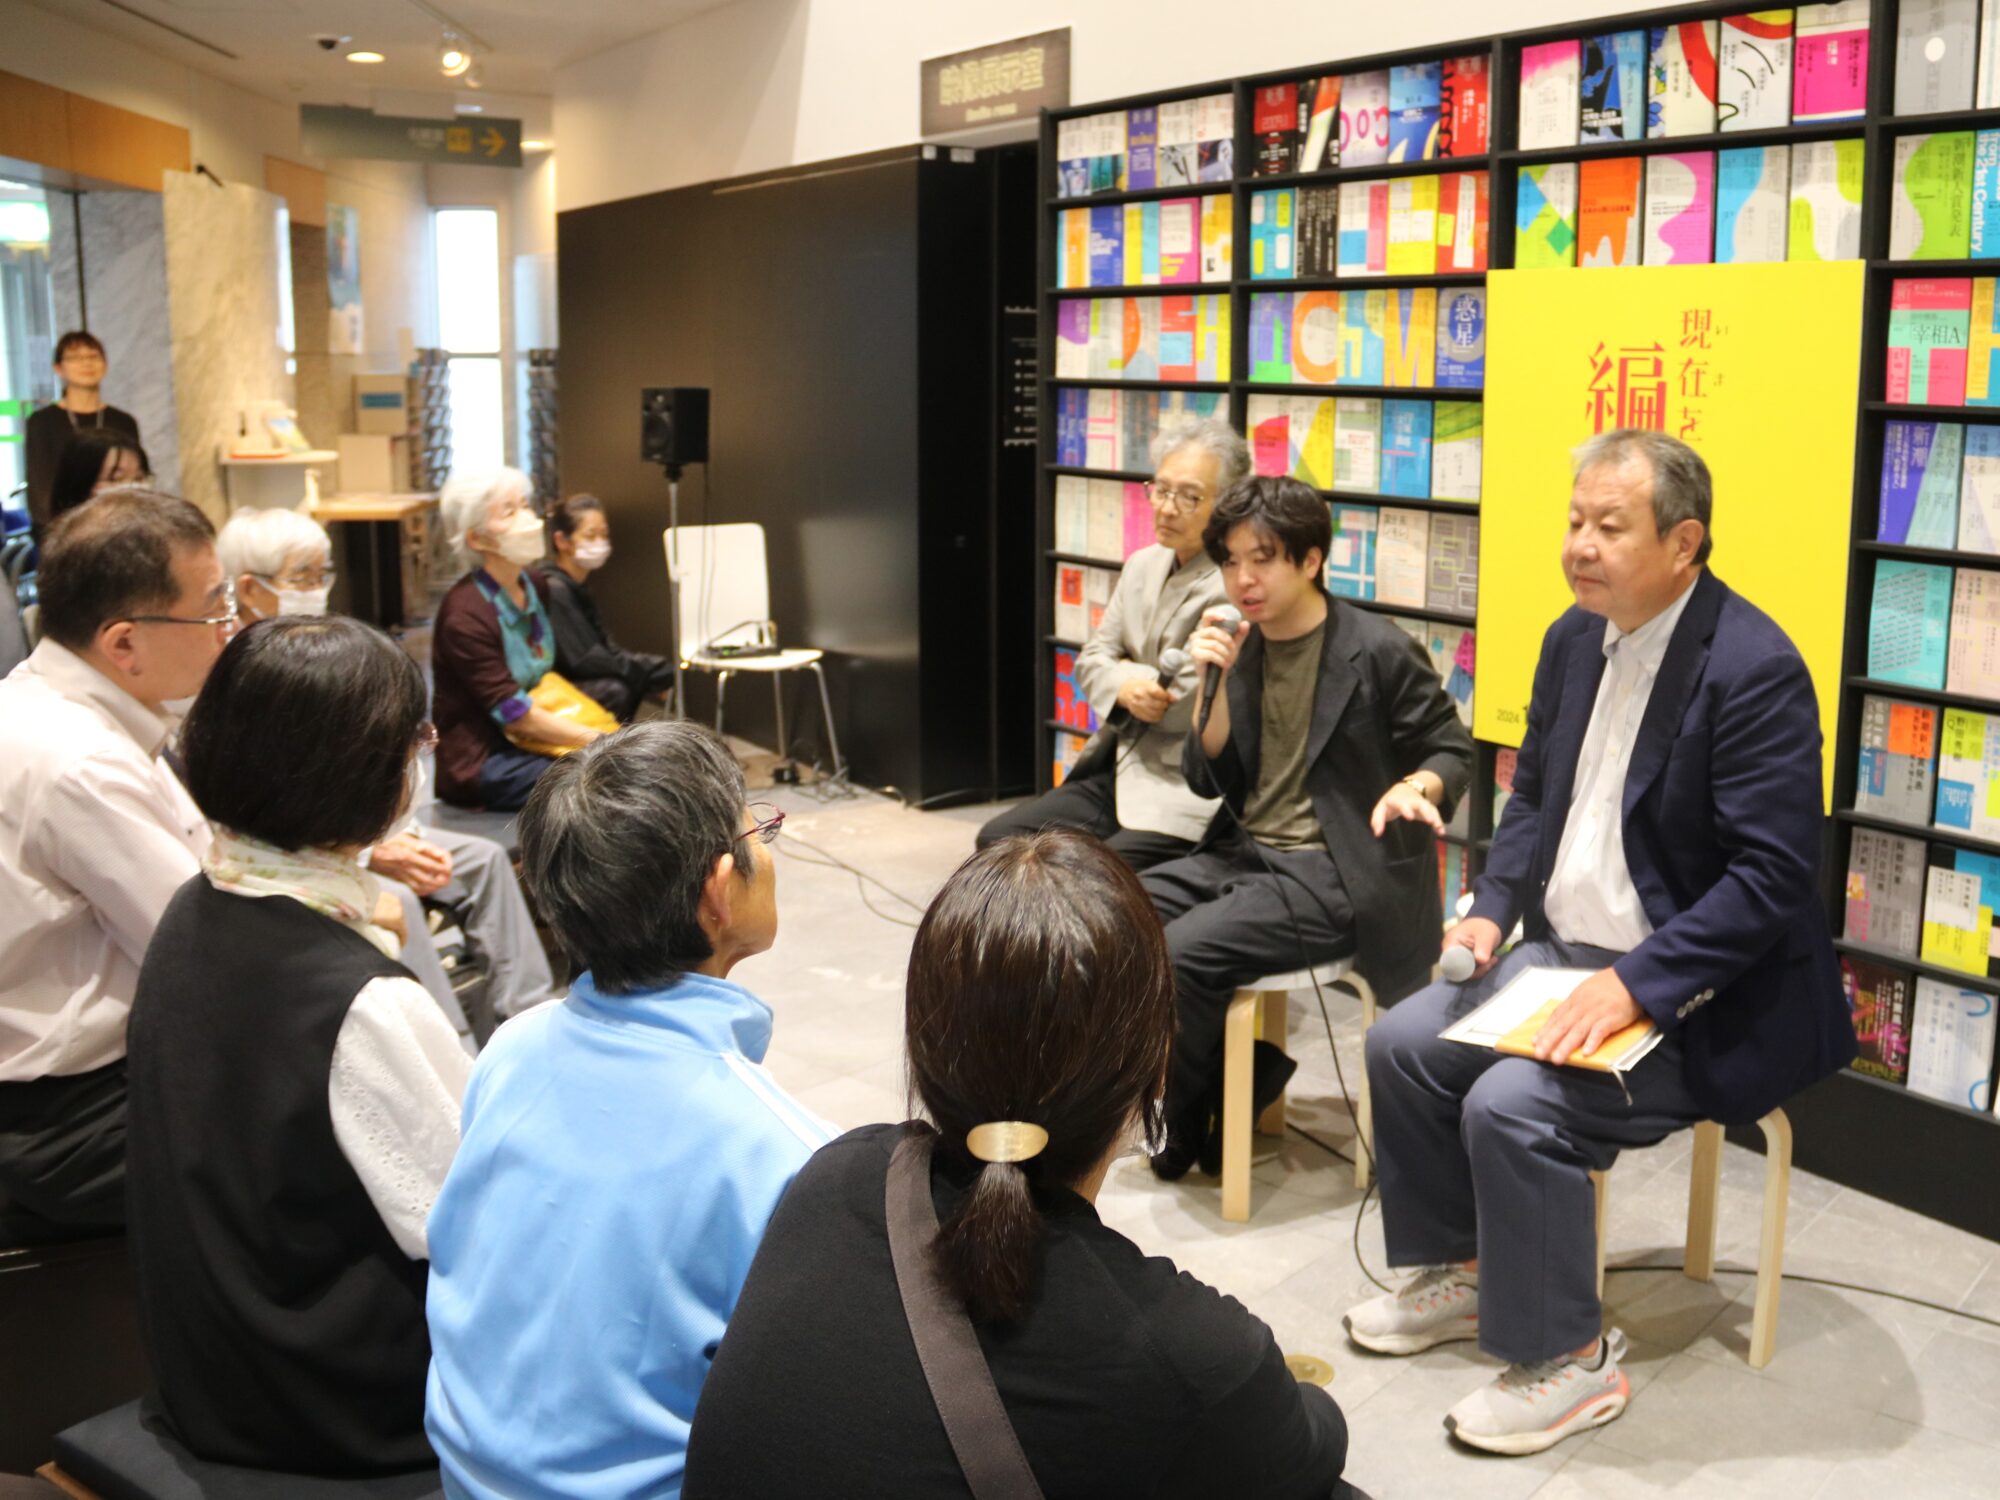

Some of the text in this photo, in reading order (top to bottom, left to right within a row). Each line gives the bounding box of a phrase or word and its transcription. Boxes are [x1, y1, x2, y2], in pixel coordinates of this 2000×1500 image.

[1971, 190, 1988, 253] Century
[1455, 294, 1477, 347] 惑星
[1584, 341, 1666, 434] 編
[1678, 309, 1712, 442] 現在を
